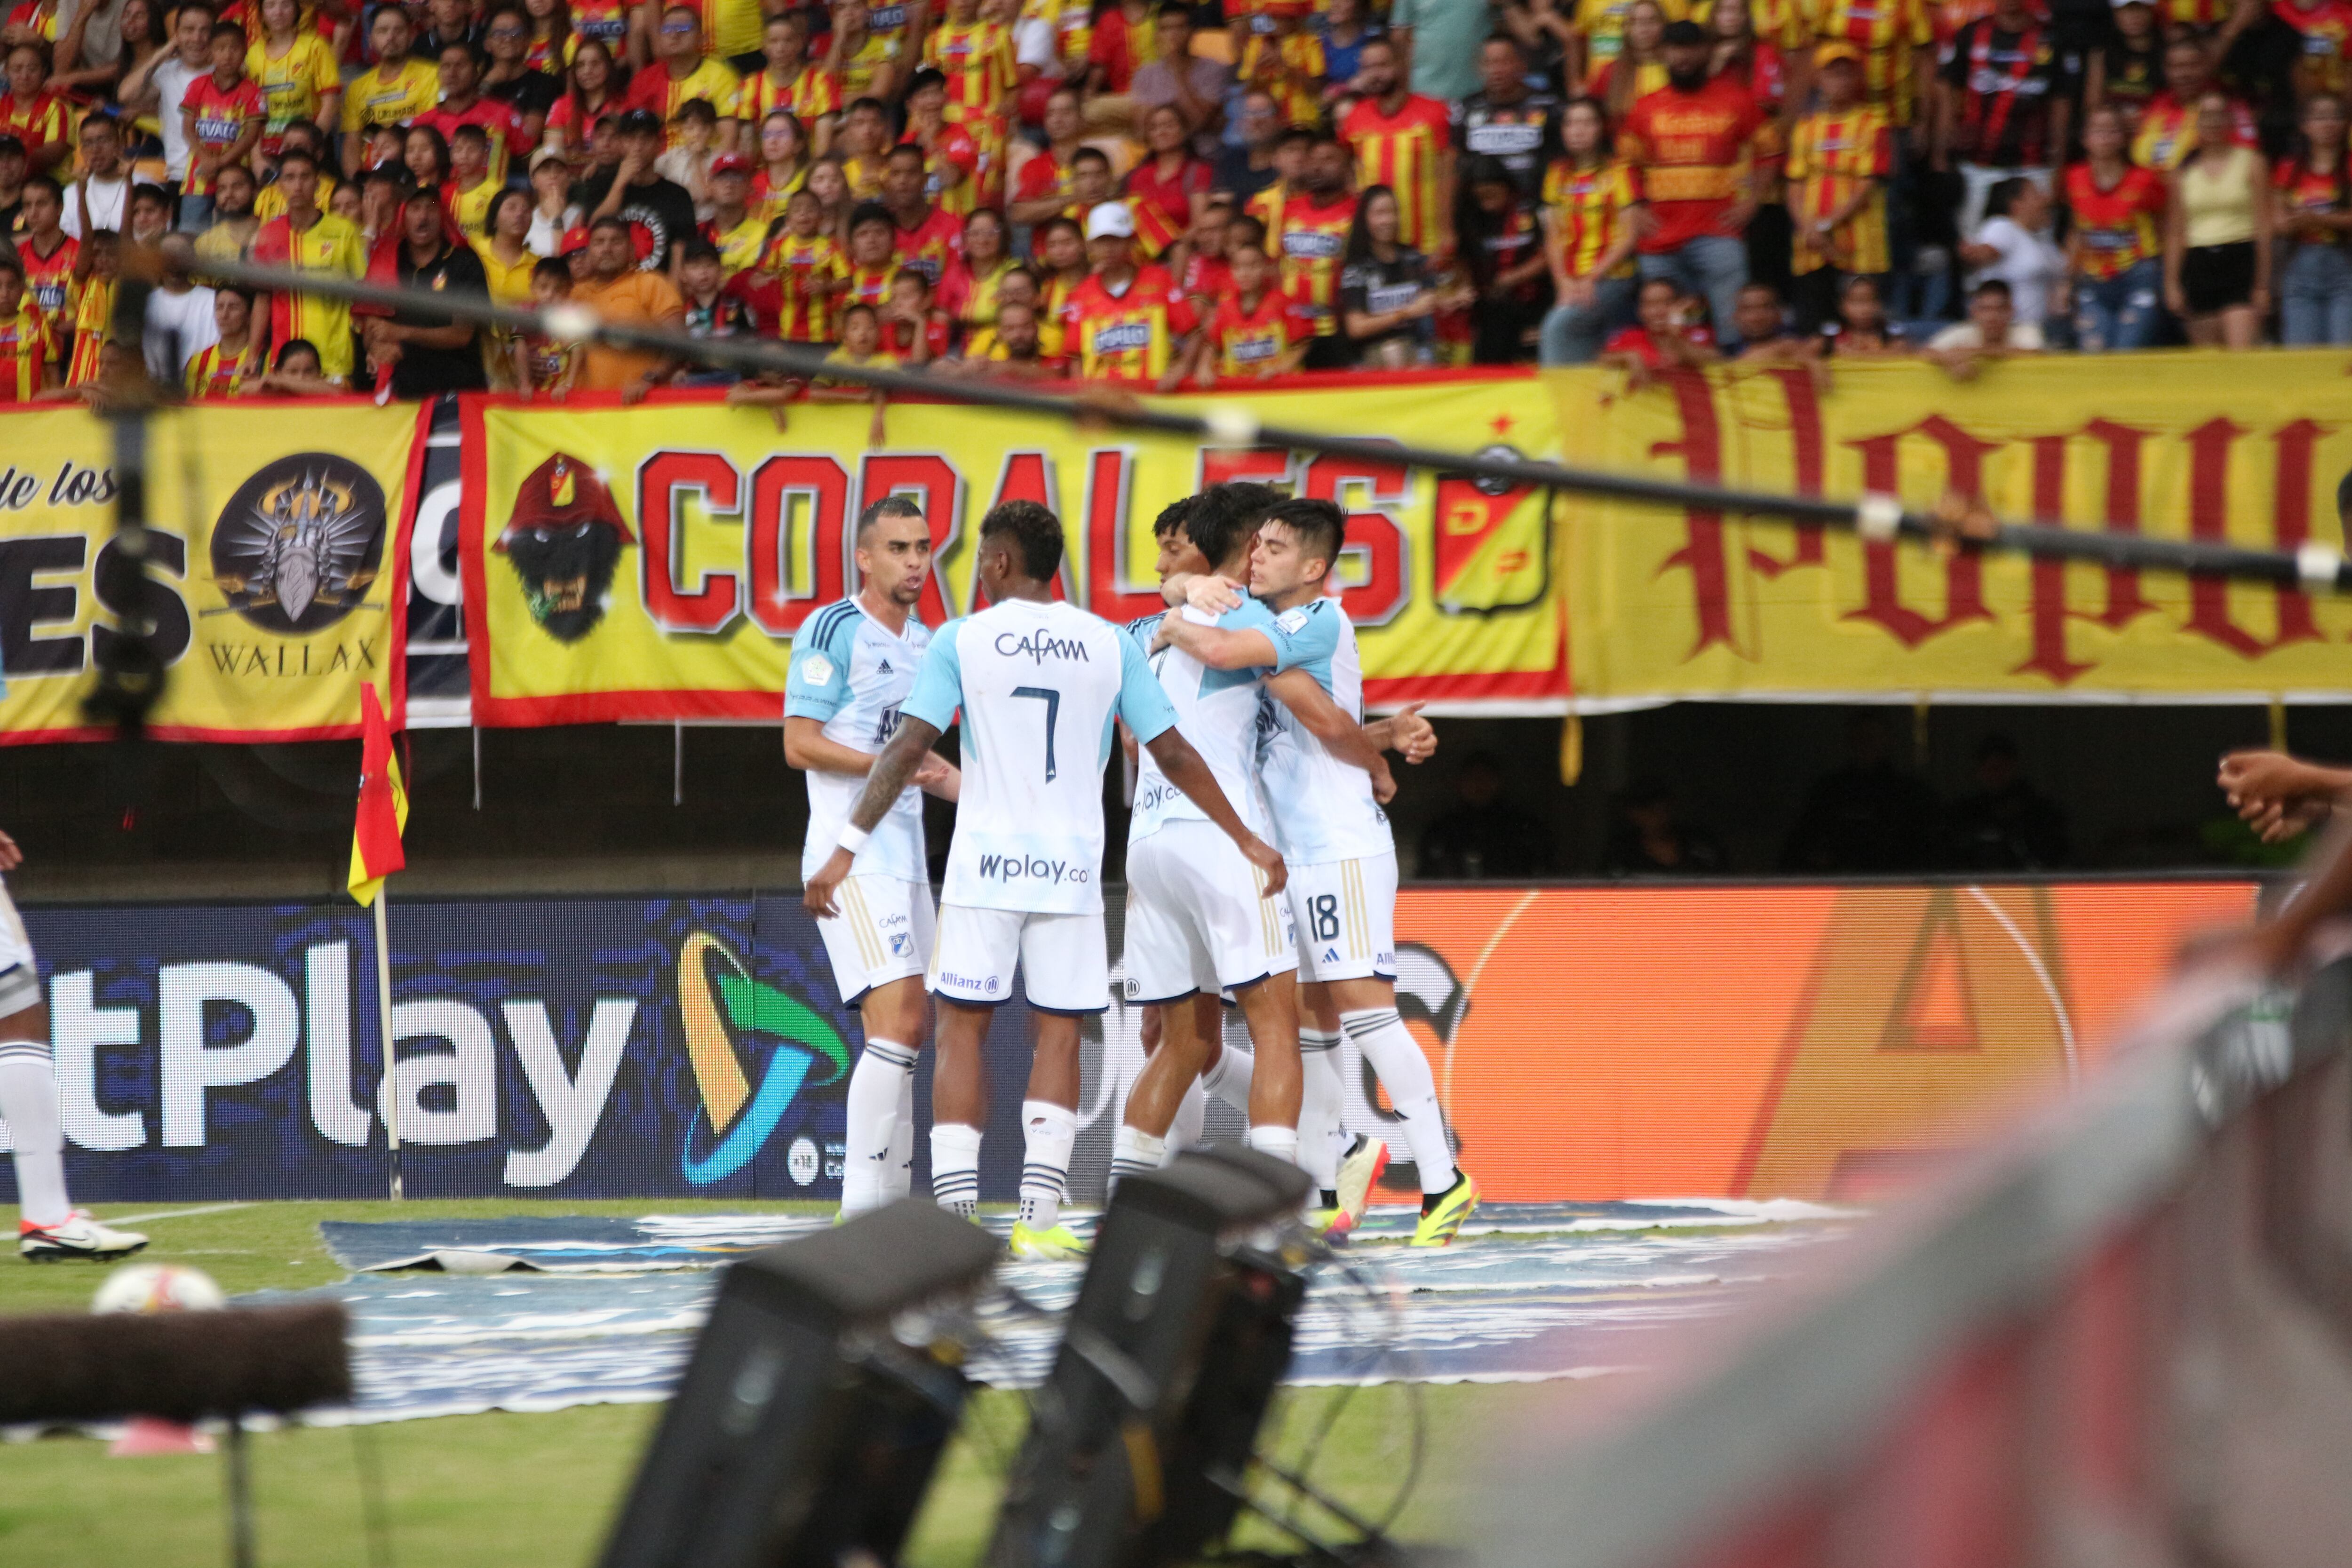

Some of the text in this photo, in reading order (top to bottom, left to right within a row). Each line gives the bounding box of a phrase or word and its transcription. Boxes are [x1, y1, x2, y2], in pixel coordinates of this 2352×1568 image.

[46, 460, 120, 506] los
[636, 436, 1410, 639] CORALS
[1649, 368, 2352, 685] Popu
[208, 638, 378, 678] WALLAX
[1009, 686, 1060, 785] 7
[979, 853, 1089, 884] Wplay.co
[1306, 894, 1340, 943] 18
[941, 971, 982, 990] Allianz
[0, 938, 638, 1187] tPlay
